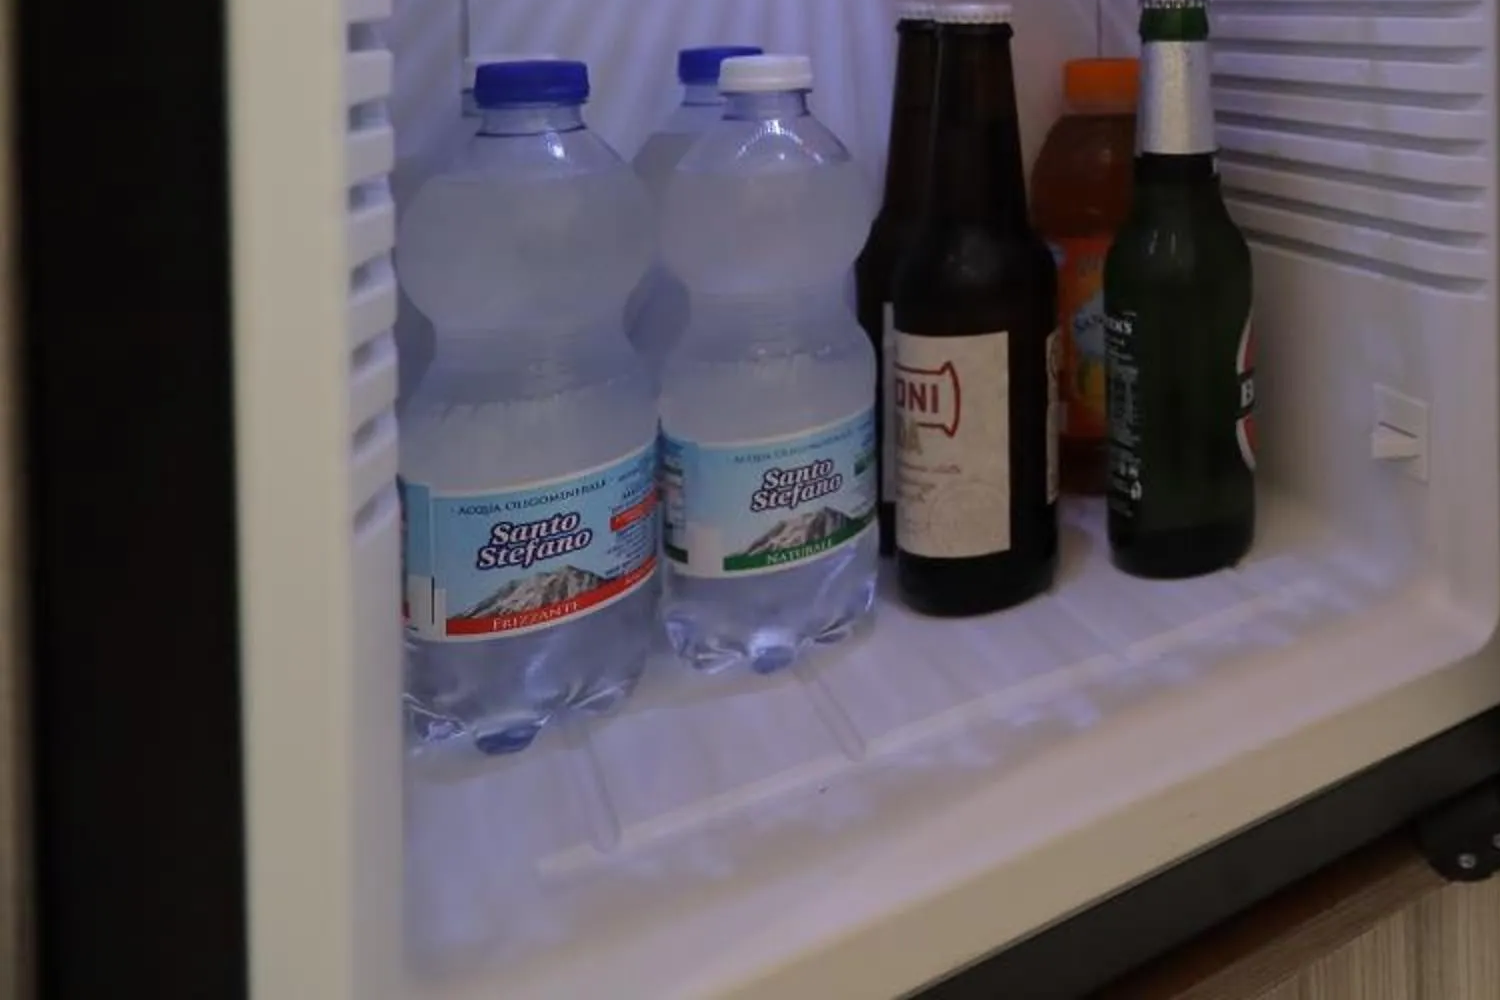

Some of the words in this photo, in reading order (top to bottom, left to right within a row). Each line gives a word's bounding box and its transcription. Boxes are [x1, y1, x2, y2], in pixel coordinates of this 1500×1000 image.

[763, 458, 835, 491] Santo
[750, 472, 843, 512] Stefano
[491, 511, 580, 547] Santo
[477, 528, 593, 570] Stefano
[767, 538, 834, 565] NATURALE
[492, 601, 580, 630] FRIZZANTE
